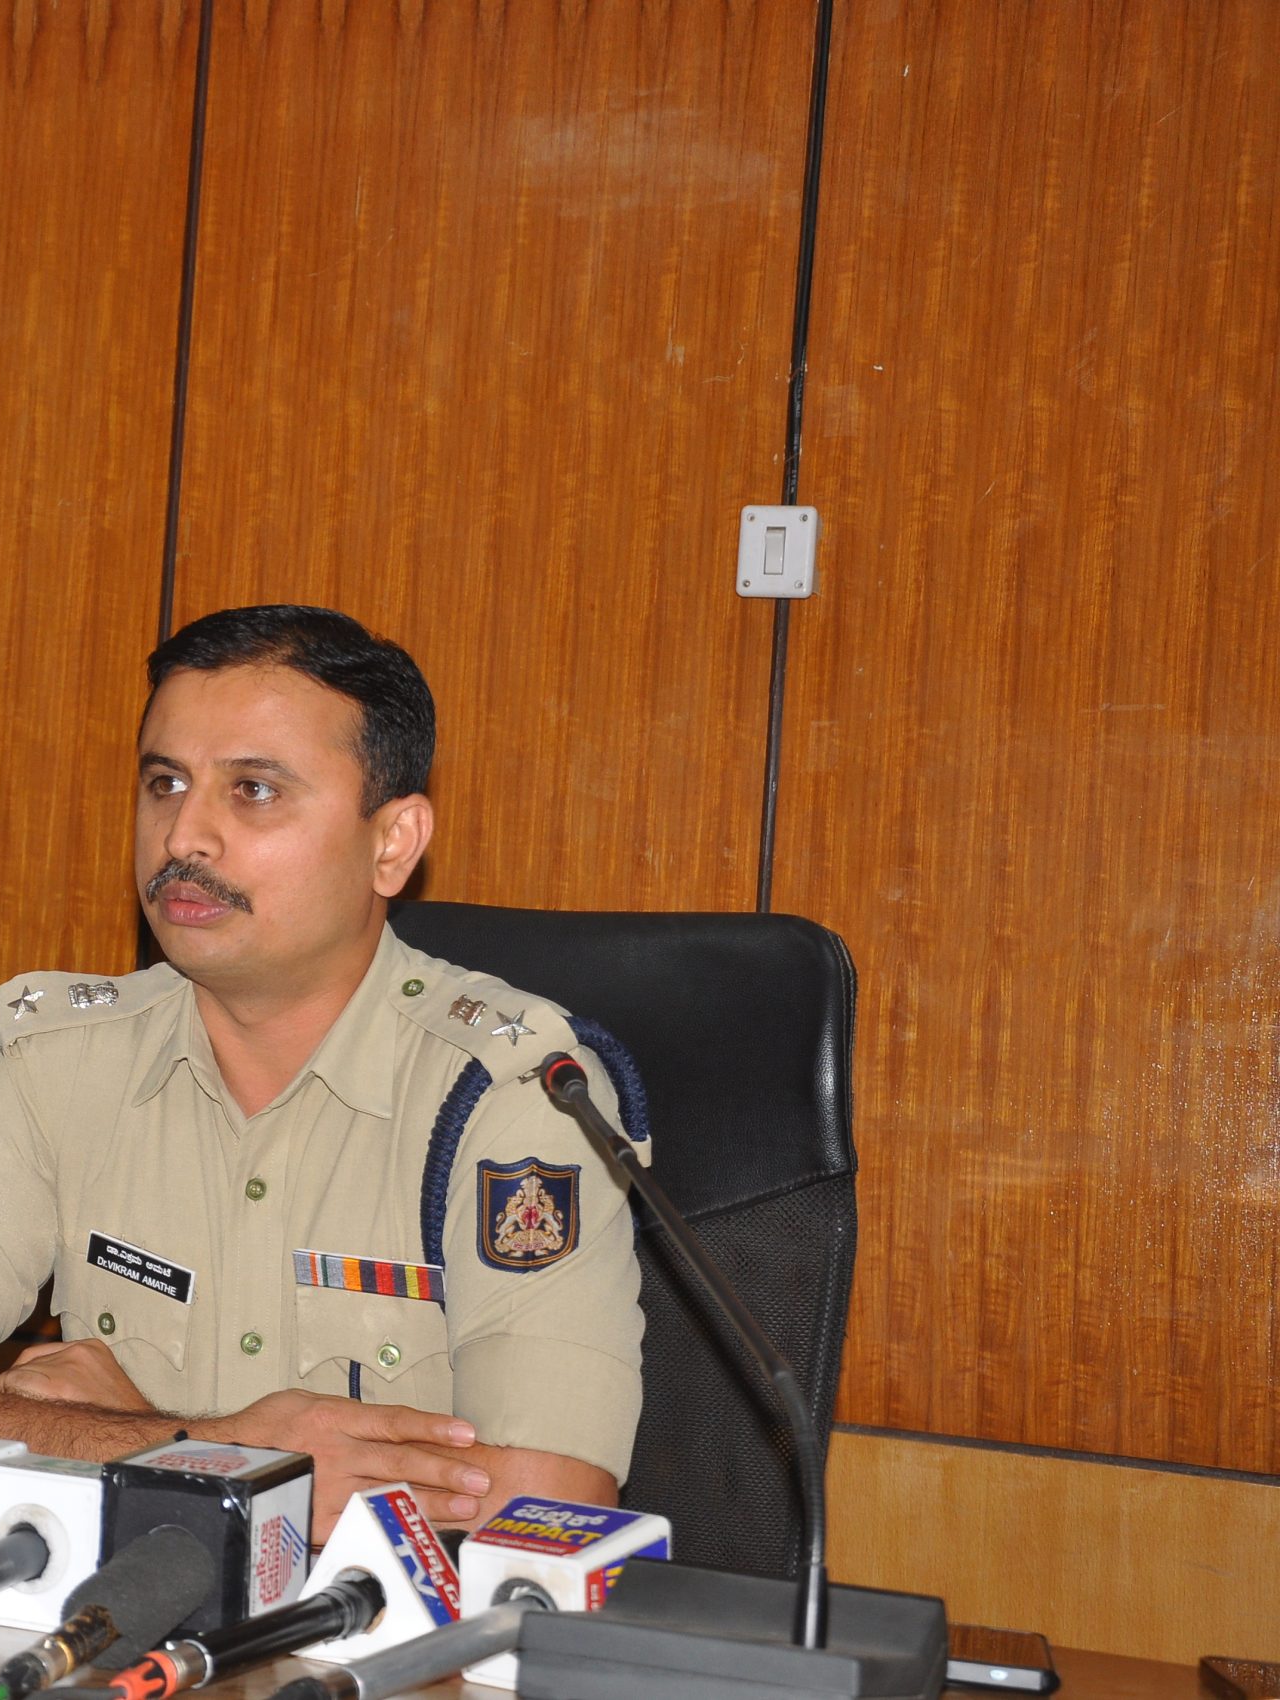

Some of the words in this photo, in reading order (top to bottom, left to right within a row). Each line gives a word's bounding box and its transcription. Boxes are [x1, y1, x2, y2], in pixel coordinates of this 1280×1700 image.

[97, 1255, 140, 1281] Dr.VIKRAM
[142, 1275, 177, 1297] AMATHE
[486, 1517, 604, 1546] IMPACT
[394, 1532, 440, 1599] TV
